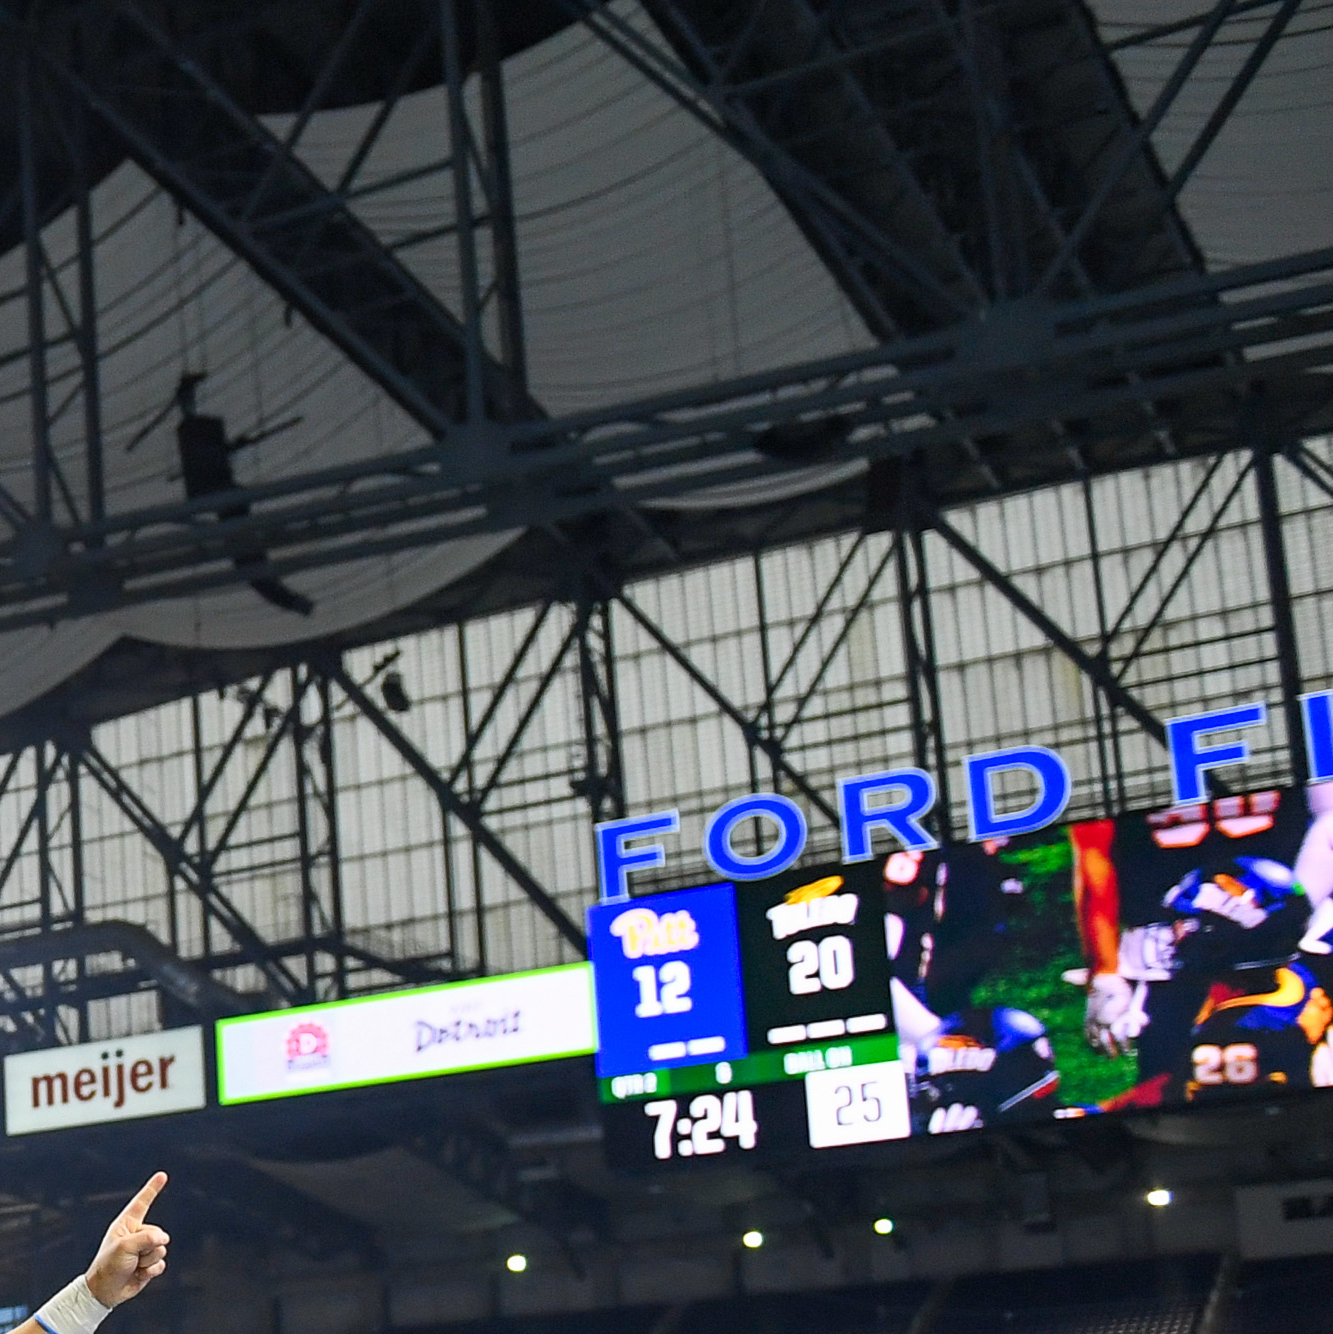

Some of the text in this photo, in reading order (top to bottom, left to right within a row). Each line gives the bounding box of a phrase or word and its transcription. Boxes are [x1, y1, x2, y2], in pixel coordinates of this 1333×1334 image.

[595, 744, 1073, 905] FORD
[610, 908, 699, 959] Pitt
[632, 935, 855, 1018] 12 20
[416, 1010, 521, 1053] Detroit
[32, 1050, 176, 1110] meijer
[1191, 1042, 1259, 1085] 26
[644, 1090, 758, 1159] 7:24
[834, 1081, 882, 1127] 25
